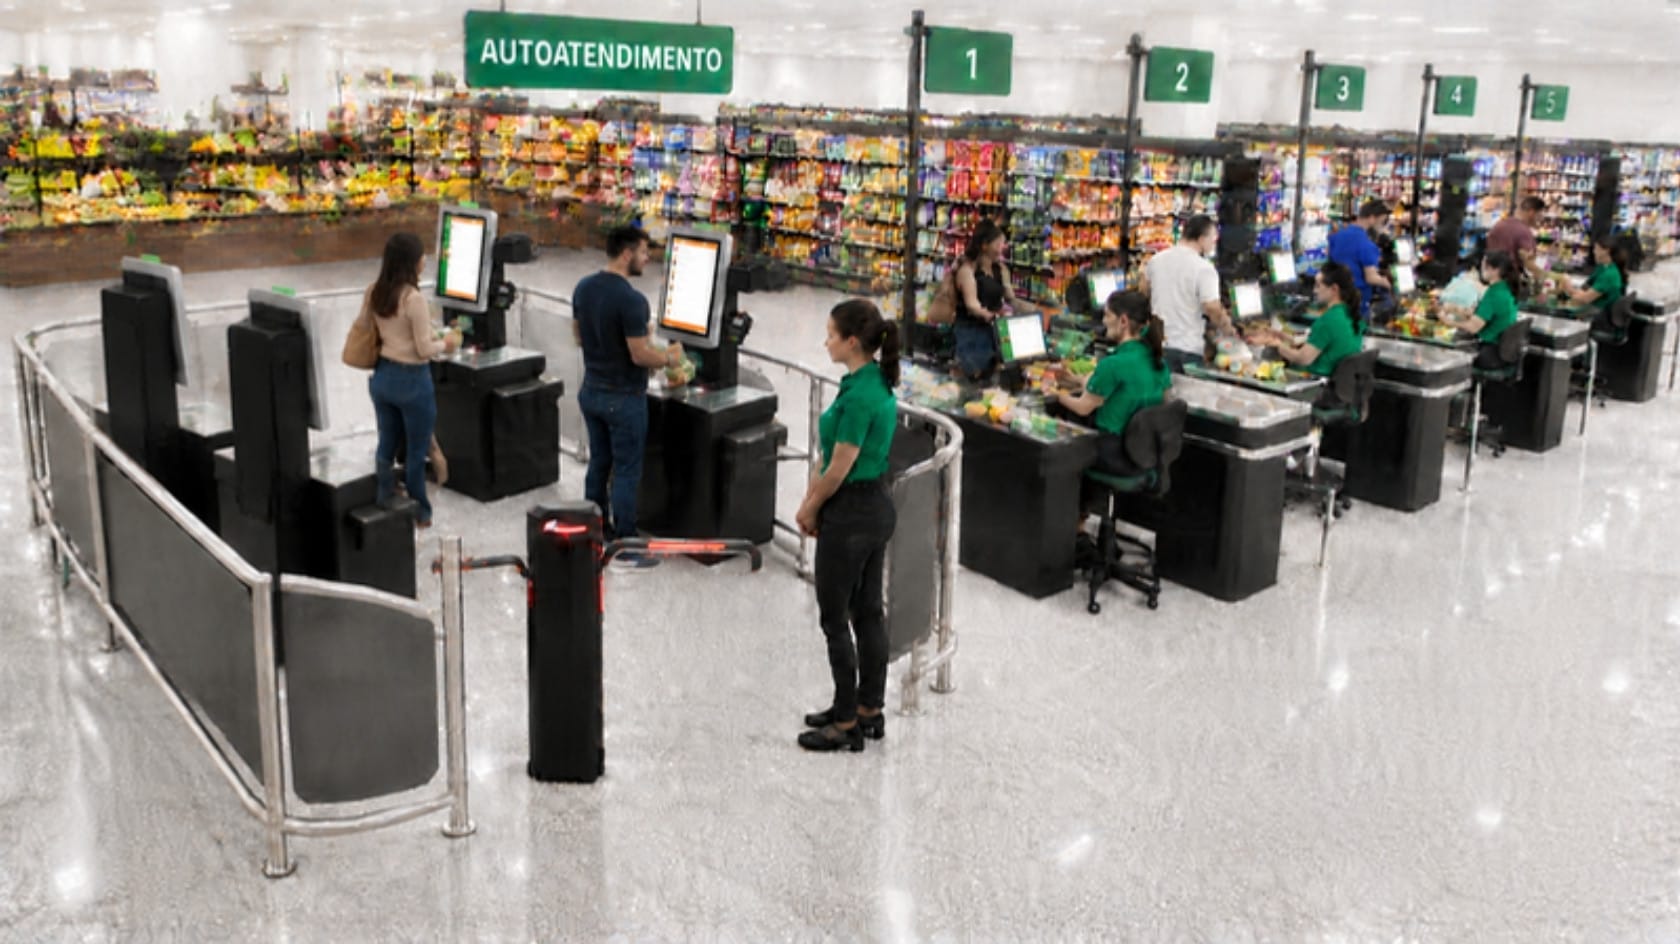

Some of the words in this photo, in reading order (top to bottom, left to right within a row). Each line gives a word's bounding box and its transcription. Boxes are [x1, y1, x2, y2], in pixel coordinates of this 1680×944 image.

[481, 38, 722, 72] AUTOATENDIMENTO
[966, 48, 977, 79] 1
[1175, 62, 1189, 92] 2
[1337, 76, 1349, 102] 3
[1451, 85, 1462, 104] 4
[1545, 92, 1555, 113] 5
